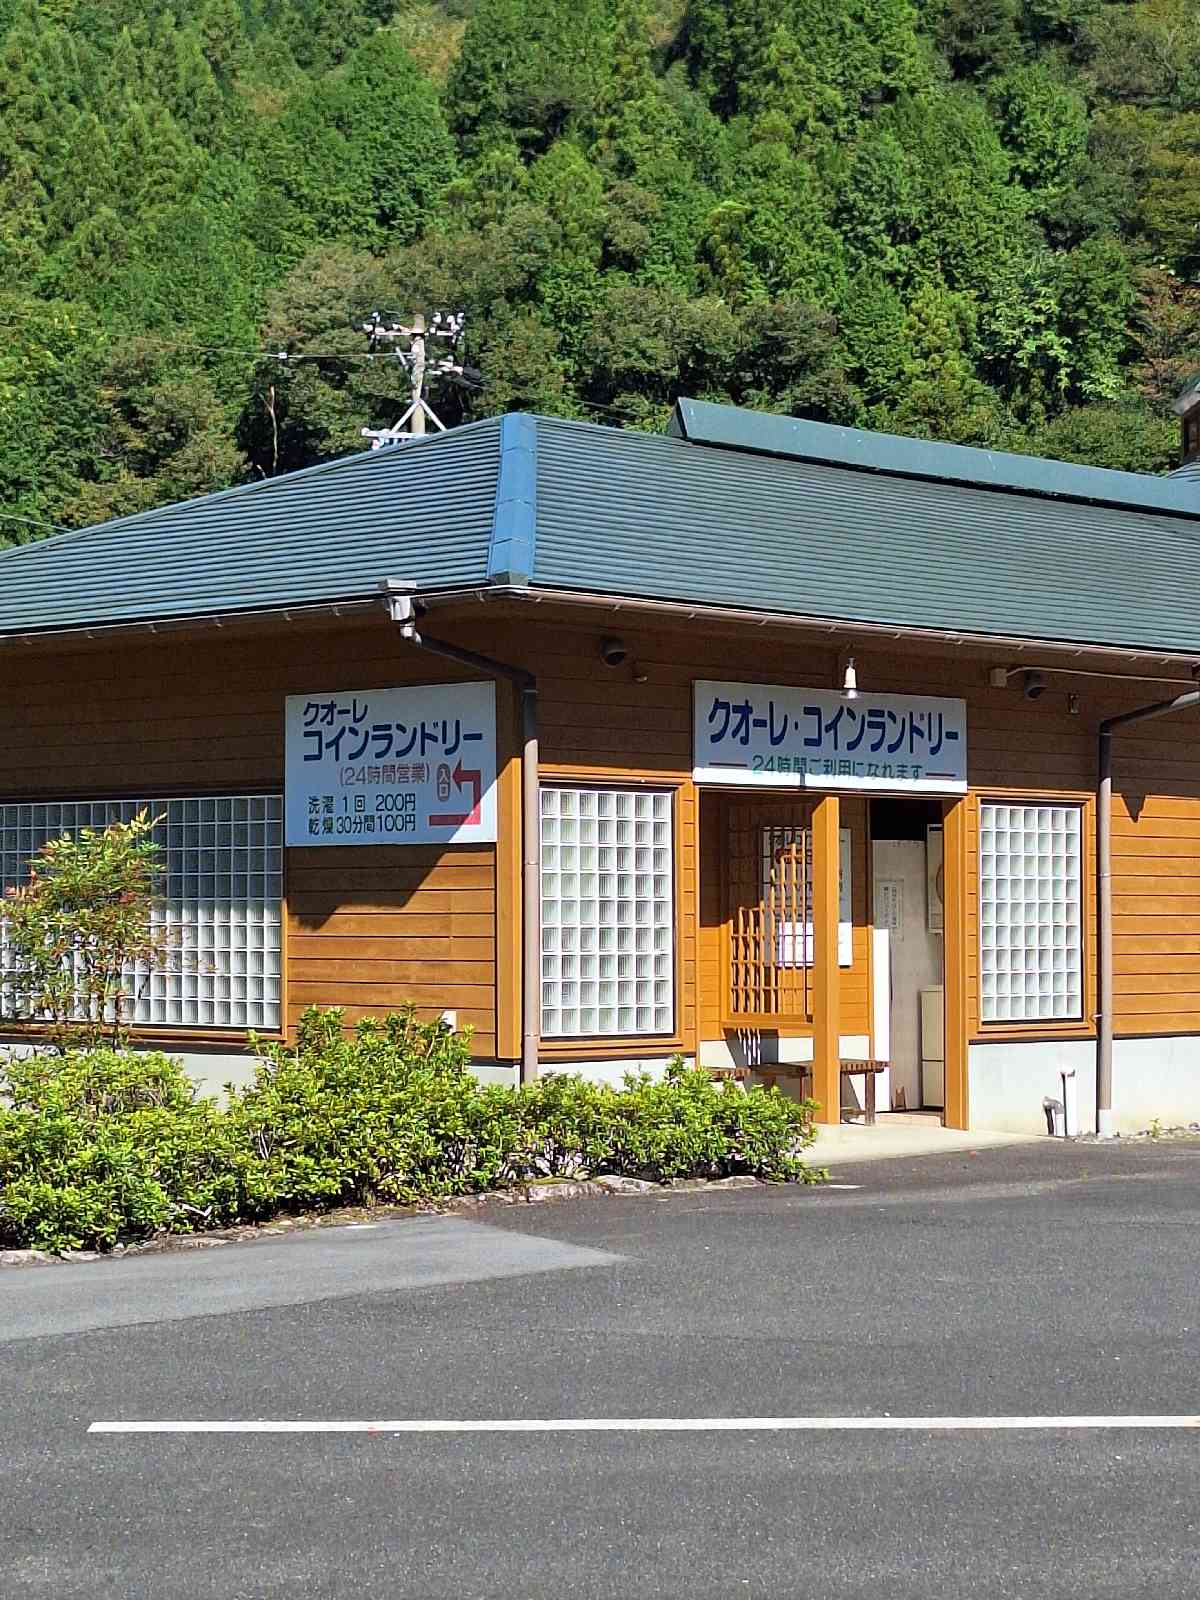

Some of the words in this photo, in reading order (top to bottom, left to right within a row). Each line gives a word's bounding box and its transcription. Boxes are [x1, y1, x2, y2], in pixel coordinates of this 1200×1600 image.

[303, 699, 368, 727] クオーレ
[708, 698, 959, 755] クオーレ・コインランドリー
[303, 719, 483, 762] コインランドリー
